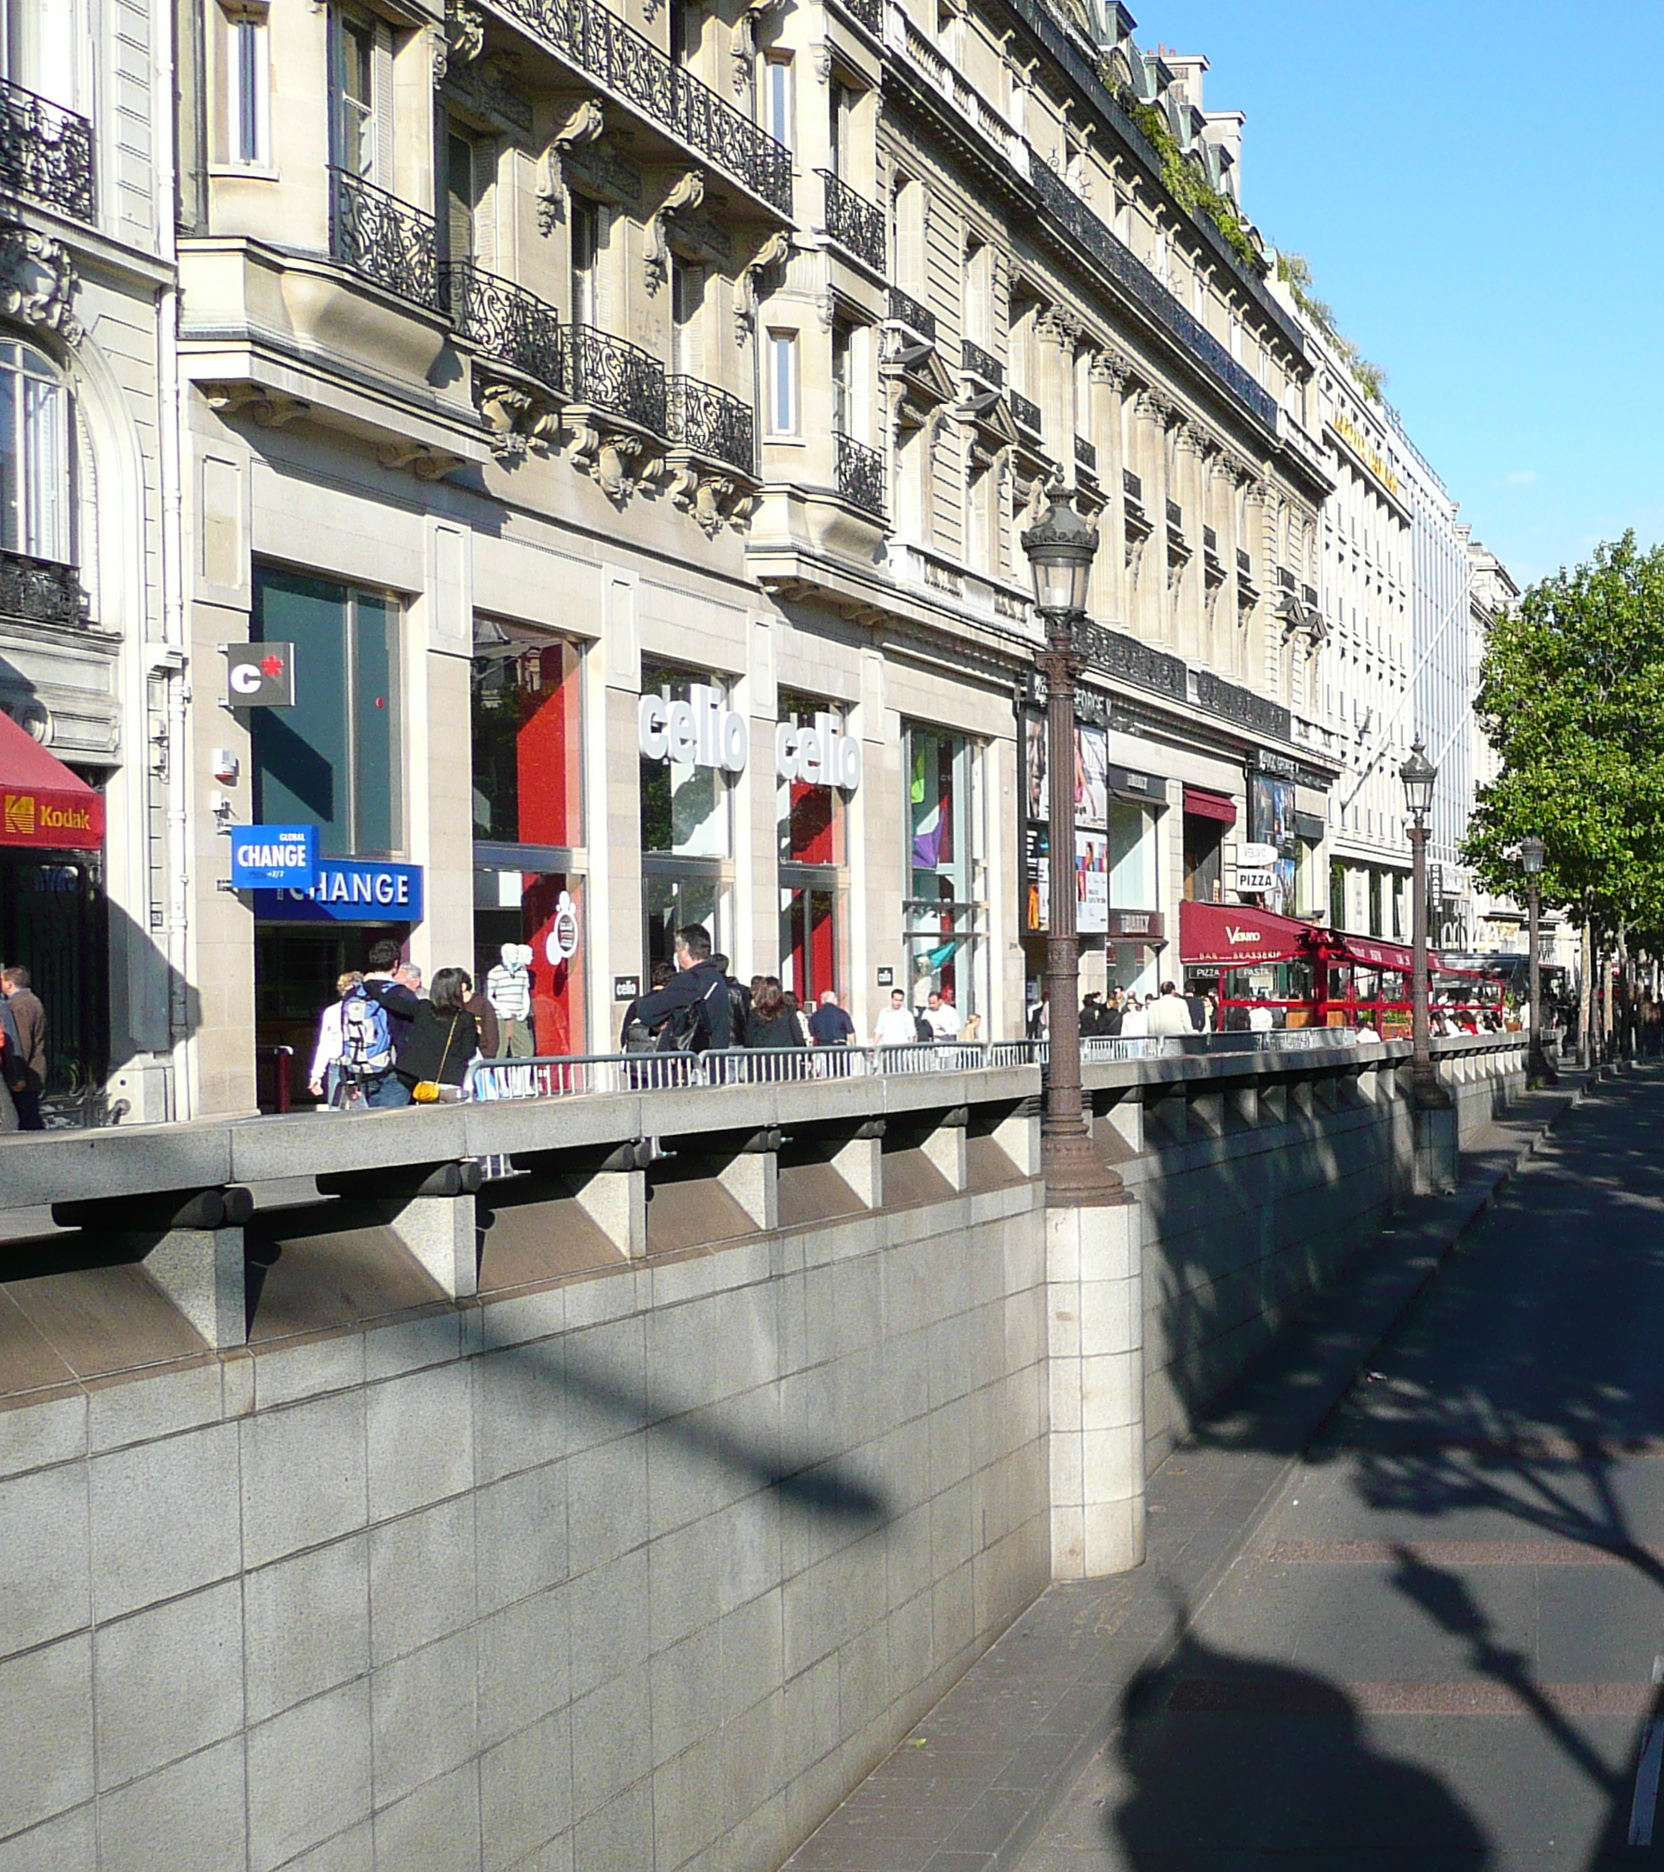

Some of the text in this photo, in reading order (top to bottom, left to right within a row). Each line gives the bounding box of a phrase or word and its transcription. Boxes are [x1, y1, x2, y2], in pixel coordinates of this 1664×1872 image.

[637, 683, 748, 772] celio
[775, 711, 861, 790] celio
[40, 805, 91, 830] Kodak
[237, 844, 306, 867] CHANGE
[1240, 875, 1272, 886] PIZZA
